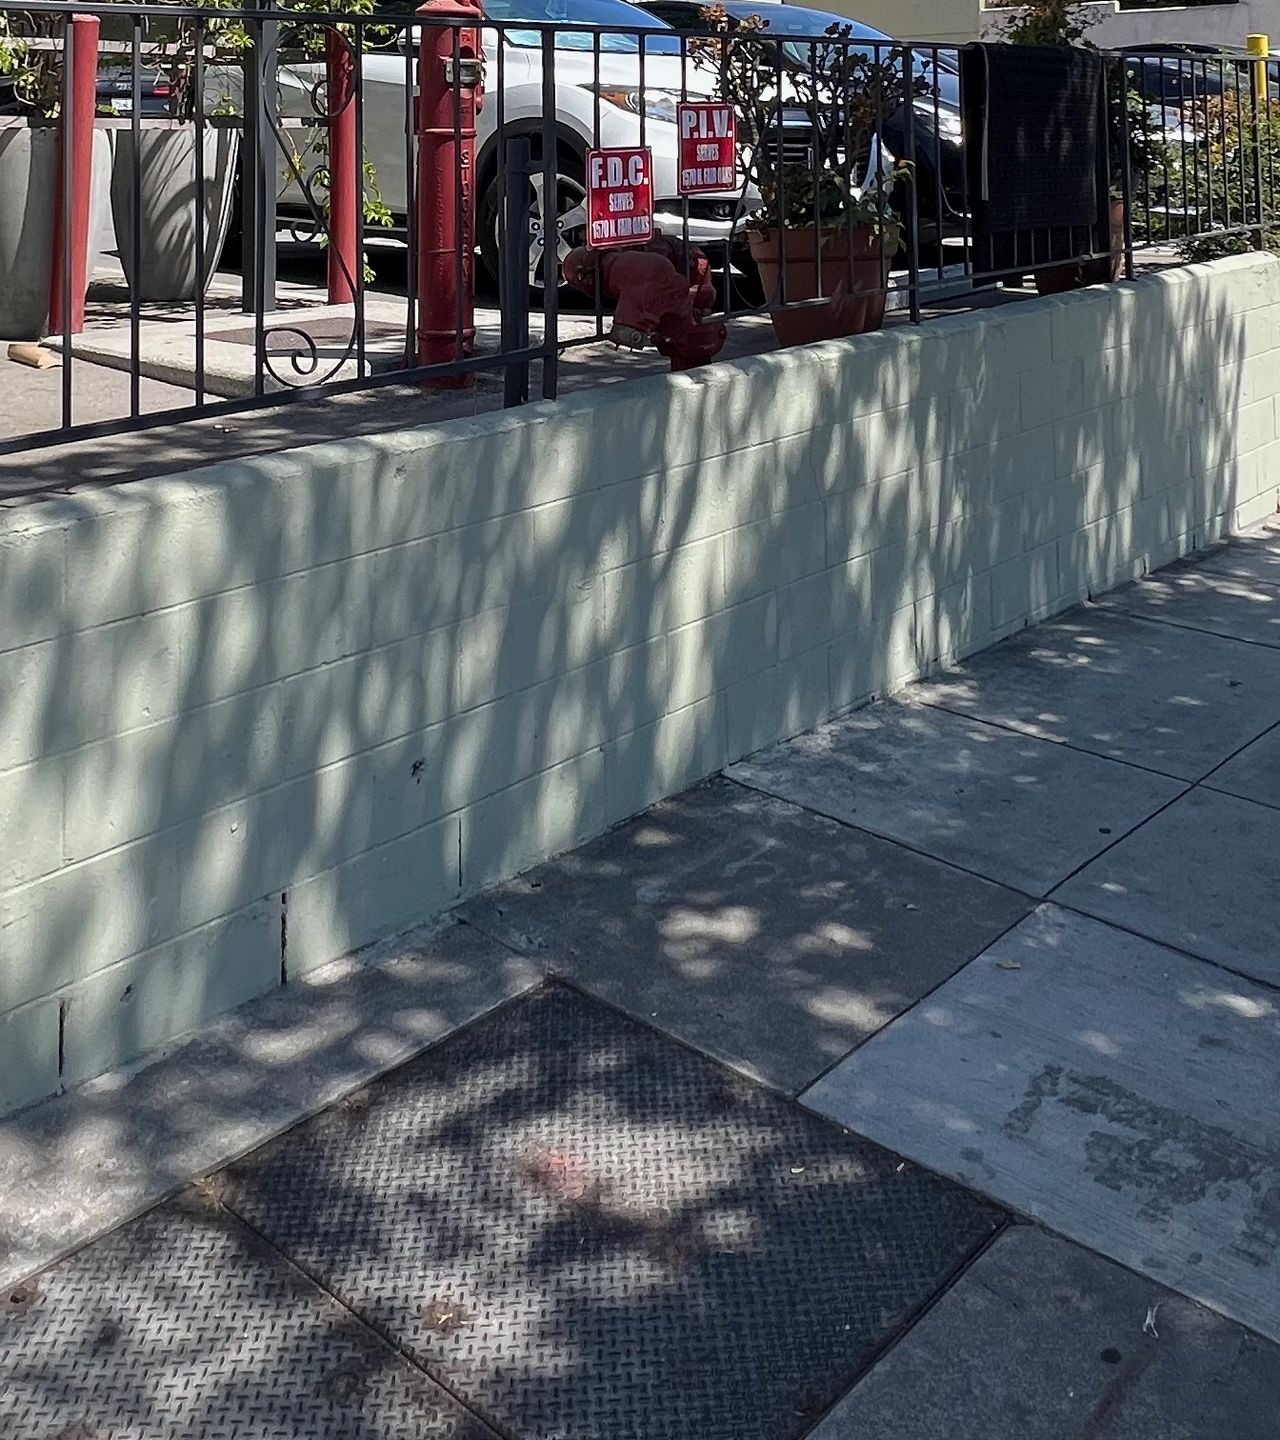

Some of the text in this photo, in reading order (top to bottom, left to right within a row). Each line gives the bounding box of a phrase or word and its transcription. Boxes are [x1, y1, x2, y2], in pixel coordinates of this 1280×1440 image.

[681, 109, 733, 139] P.I.V.
[696, 143, 719, 162] SERVES
[591, 155, 649, 189] F.D.C.
[608, 191, 634, 212] SERVES
[592, 220, 609, 239] 1570
